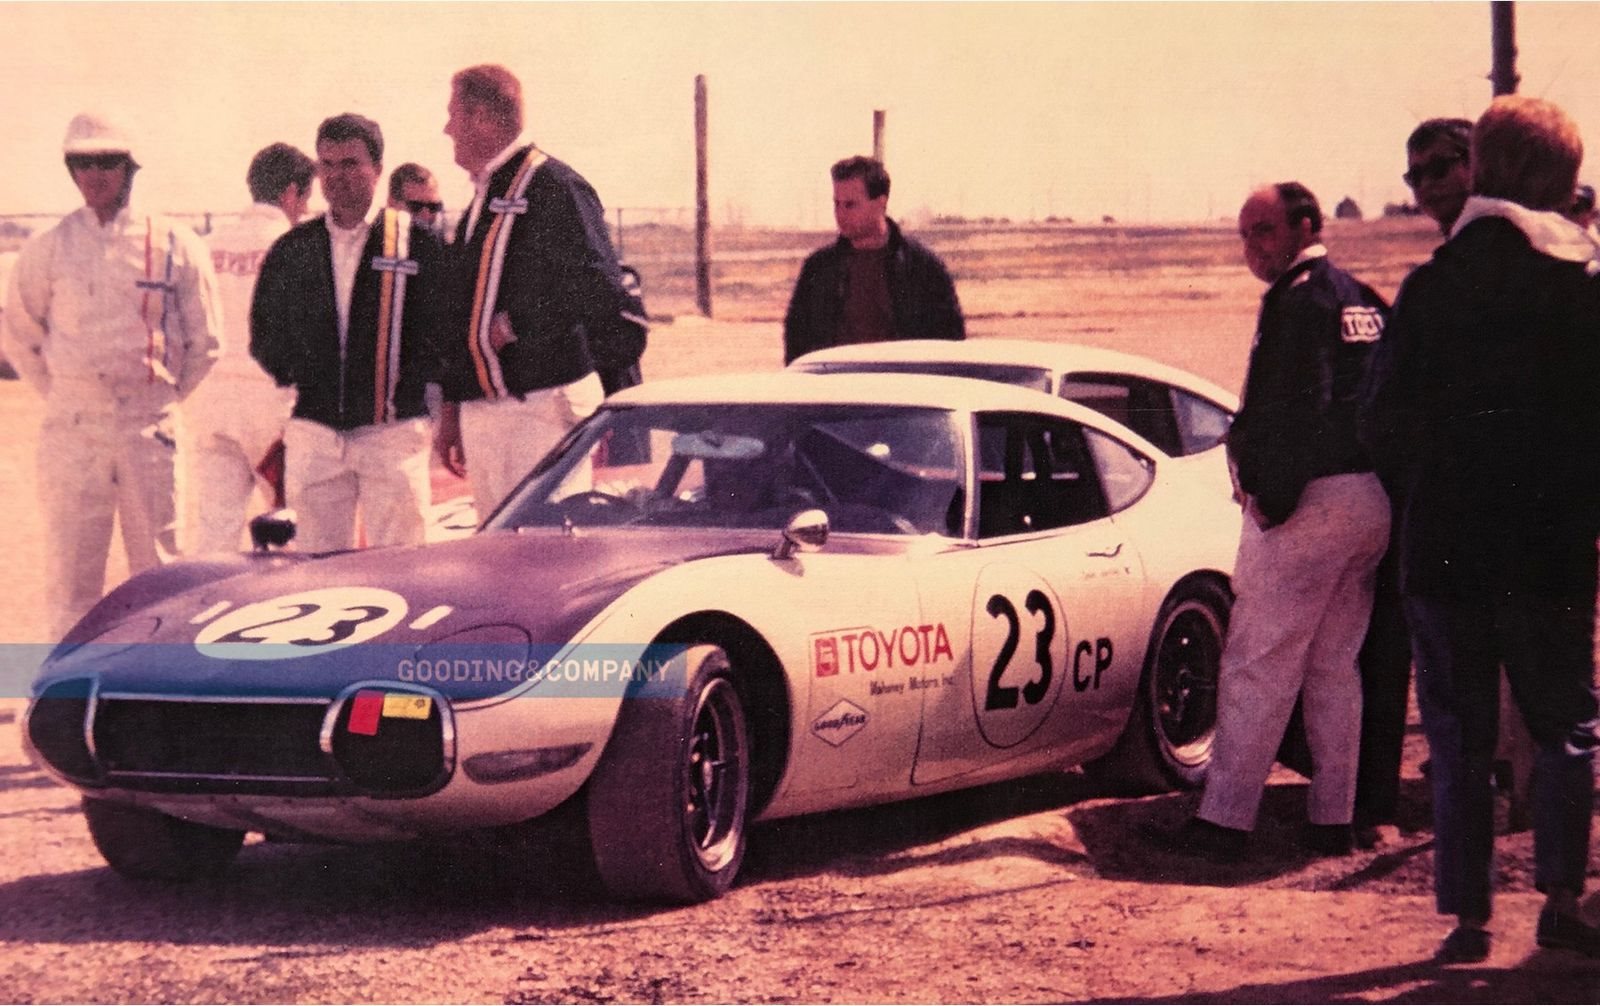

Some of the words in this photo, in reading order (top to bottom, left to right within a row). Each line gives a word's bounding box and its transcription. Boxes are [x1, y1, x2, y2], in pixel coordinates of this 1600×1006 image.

[211, 603, 390, 646] 23
[841, 622, 954, 673] TOYOTA
[985, 589, 1056, 711] 23
[1073, 637, 1113, 692] CP
